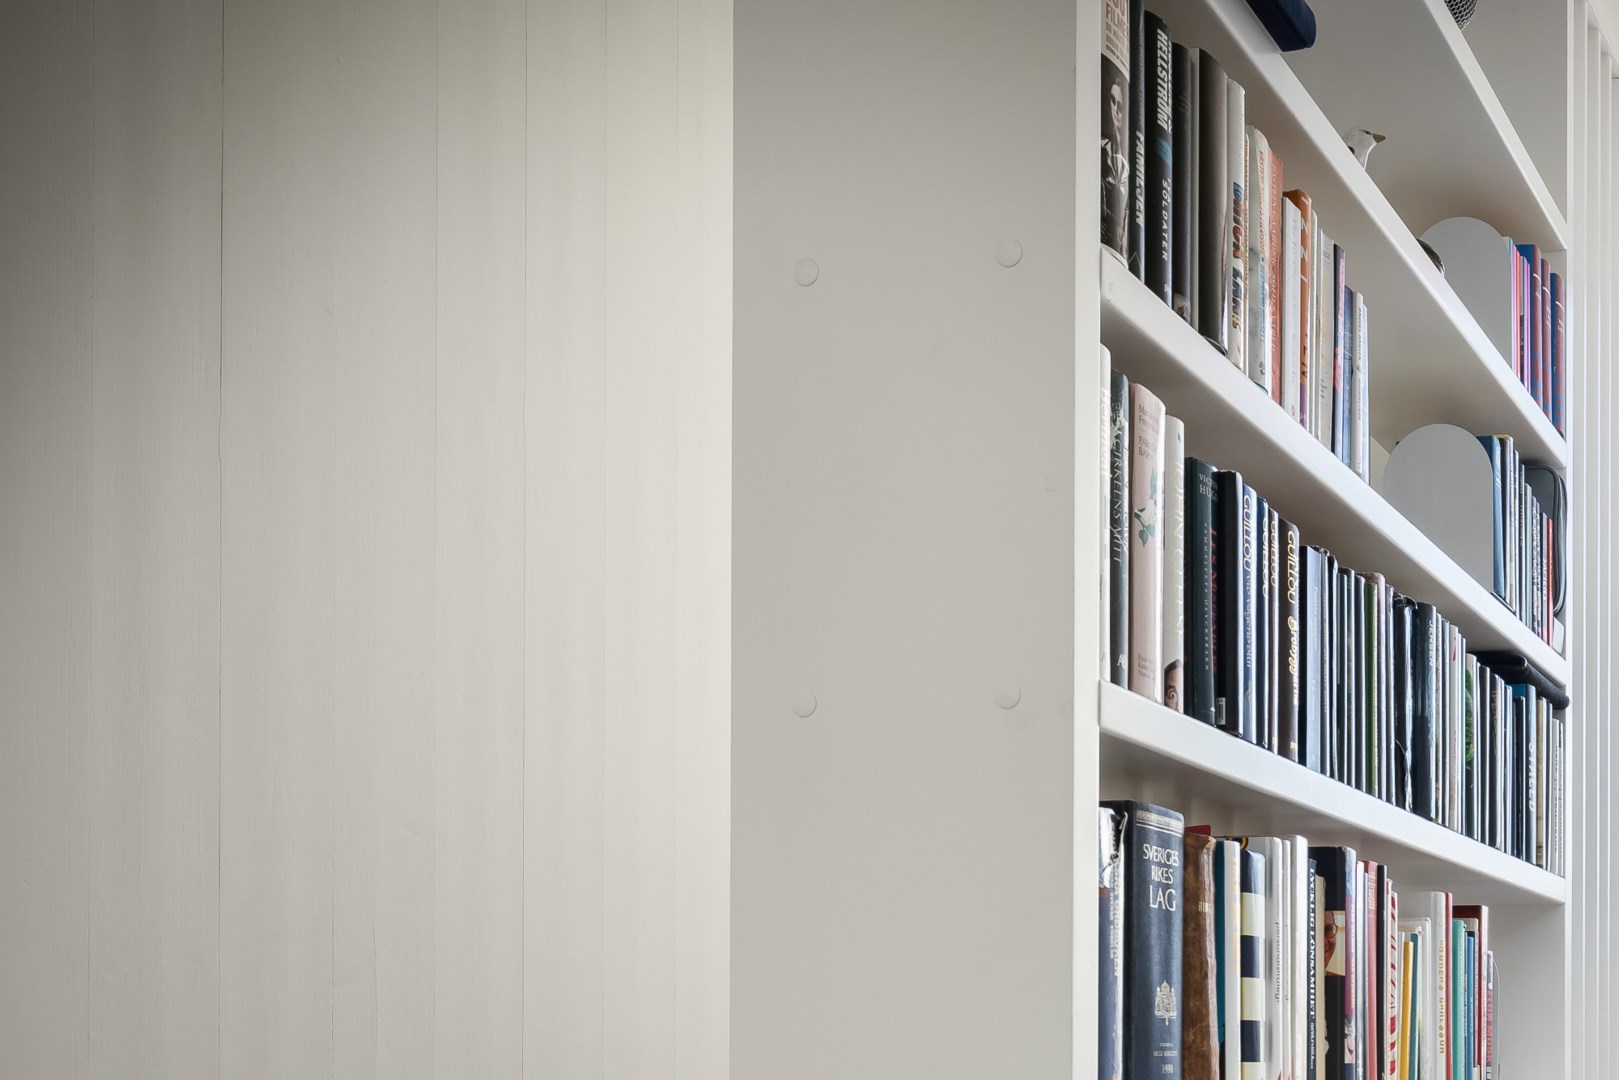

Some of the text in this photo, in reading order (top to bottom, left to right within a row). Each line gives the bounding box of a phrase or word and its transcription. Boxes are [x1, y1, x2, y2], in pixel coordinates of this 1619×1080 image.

[1156, 28, 1169, 131] HELLSTRÖM
[1135, 130, 1145, 229] FAMILJEN
[1161, 178, 1169, 262] SOLDATER
[1232, 181, 1245, 332] BRICK LANE
[1113, 438, 1122, 523] CIRKELNS
[1244, 494, 1254, 573] GUILLOU
[1270, 519, 1279, 588] GUILLOU
[1287, 529, 1299, 605] GUILLOU
[1142, 843, 1180, 867] SVERIGES
[1151, 865, 1174, 885] RIKES
[1149, 884, 1177, 912] LAG
[1308, 929, 1317, 1020] LÖNSAMHET
